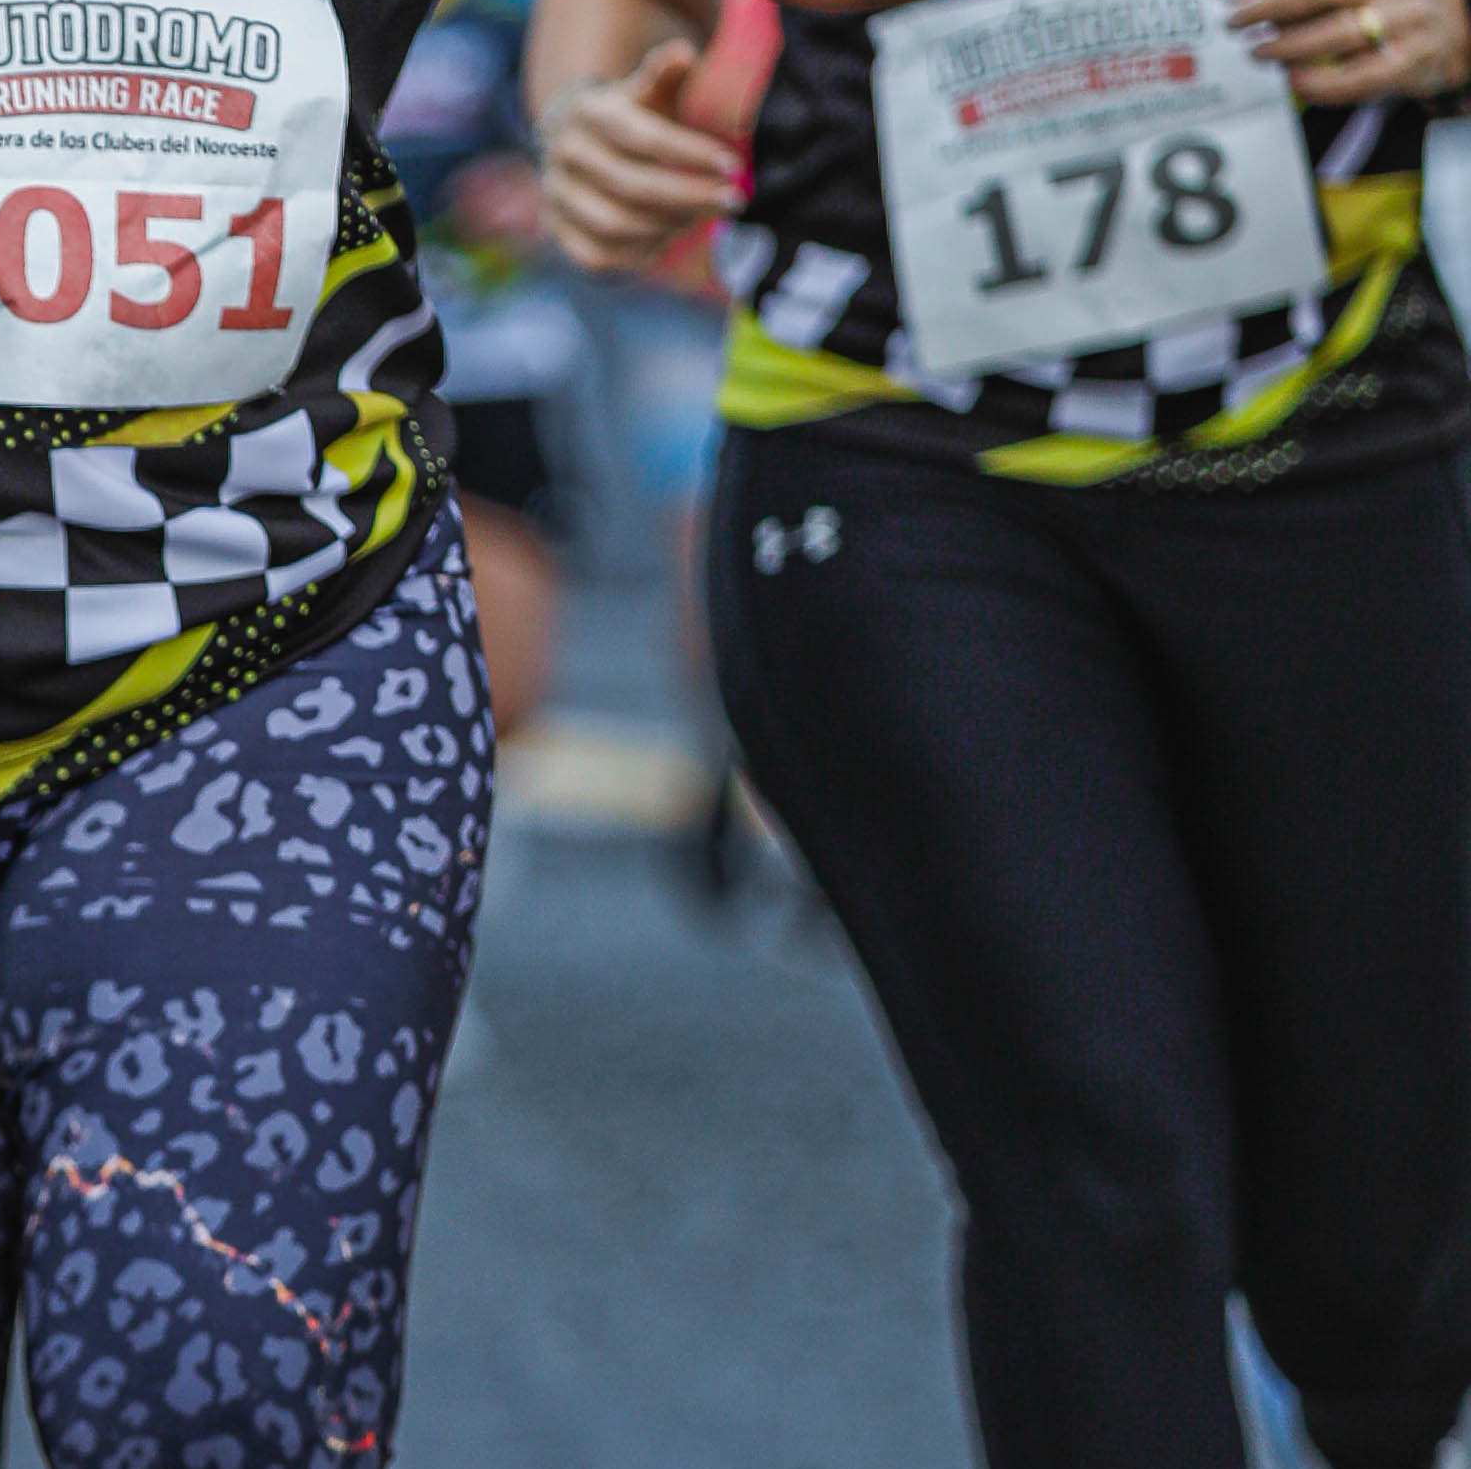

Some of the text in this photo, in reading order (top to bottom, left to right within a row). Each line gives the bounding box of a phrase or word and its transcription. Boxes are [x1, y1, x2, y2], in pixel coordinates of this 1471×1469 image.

[138, 77, 222, 123] RACE
[29, 129, 55, 149] de
[60, 130, 87, 150] los
[91, 130, 155, 153] Clubes
[160, 133, 190, 155] del
[194, 135, 279, 159] Noroeste
[958, 133, 1240, 297] 178
